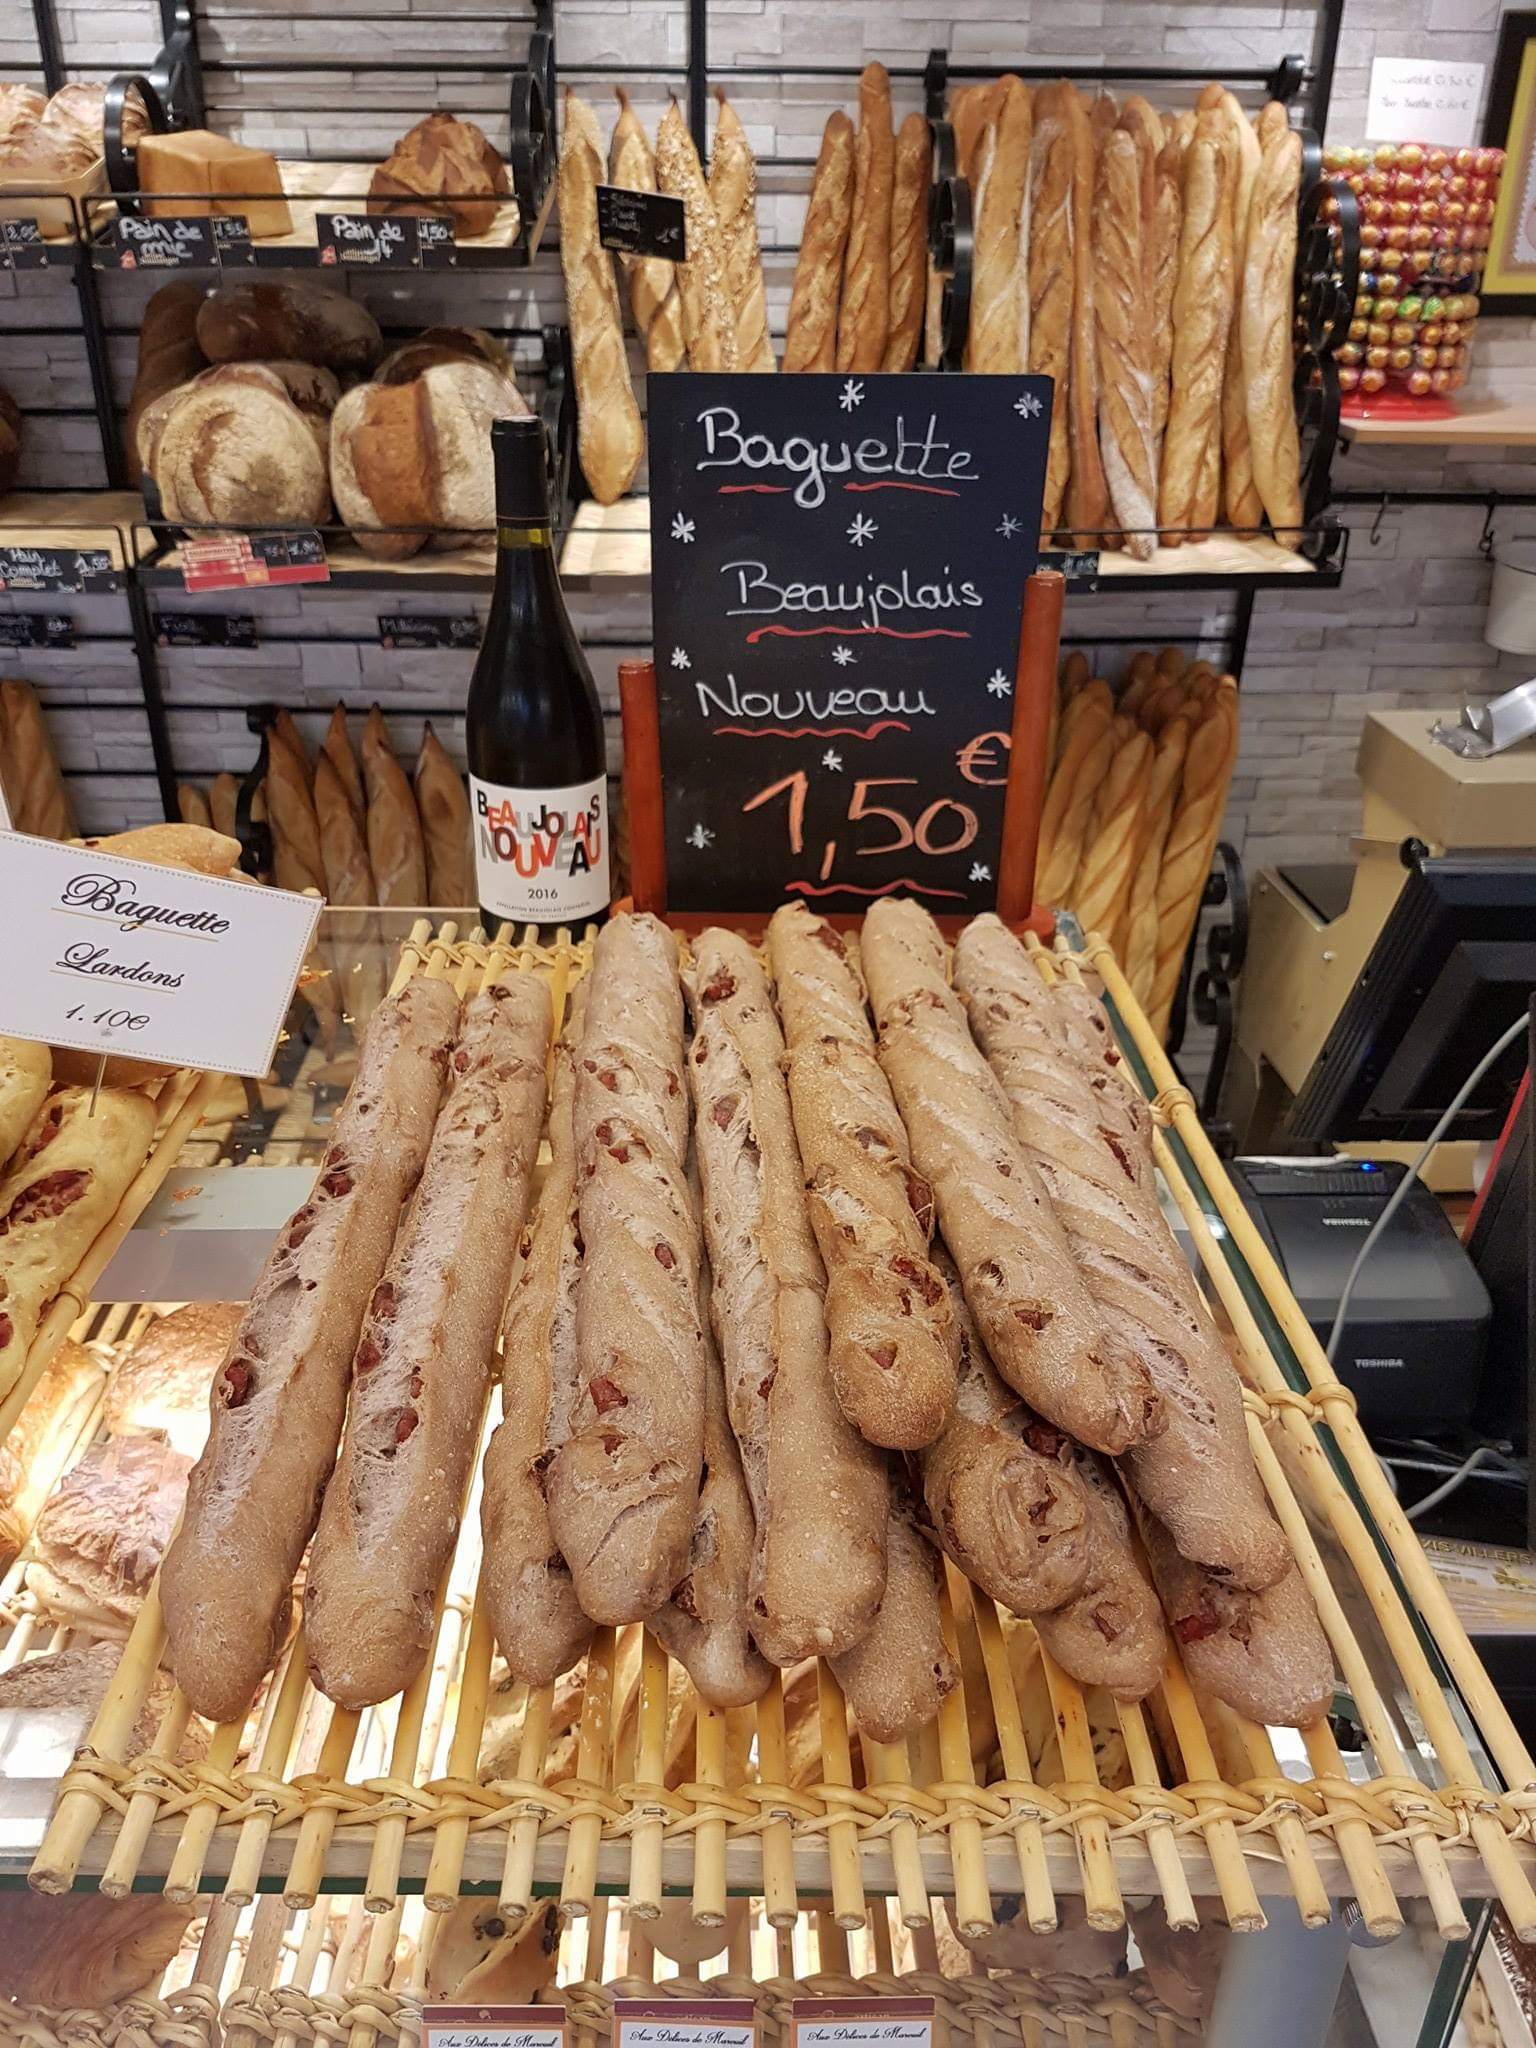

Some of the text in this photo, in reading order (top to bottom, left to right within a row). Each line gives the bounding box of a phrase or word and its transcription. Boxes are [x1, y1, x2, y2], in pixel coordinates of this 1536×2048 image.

[119, 216, 173, 242] Pain
[173, 220, 203, 241] de
[140, 241, 193, 258] mie
[331, 214, 405, 242] Pain de
[697, 406, 980, 508] Baguette
[719, 561, 983, 629] Beaujolais
[695, 673, 937, 721] Nouveau
[955, 731, 1013, 785] €
[476, 790, 600, 839] BEAUJOLAIS
[742, 770, 979, 881] 1,50
[480, 825, 601, 879] NOUVEAU
[61, 873, 230, 932] Baguette
[527, 888, 558, 899] 2016
[55, 942, 185, 989] Lardons
[1355, 1358, 1404, 1369] TOSHIBA
[438, 2035, 461, 2048] Aux
[501, 2036, 511, 2048] de
[630, 2028, 653, 2042] Aux
[692, 2032, 702, 2044] de
[807, 2028, 830, 2042] Aux
[869, 2028, 879, 2040] de
